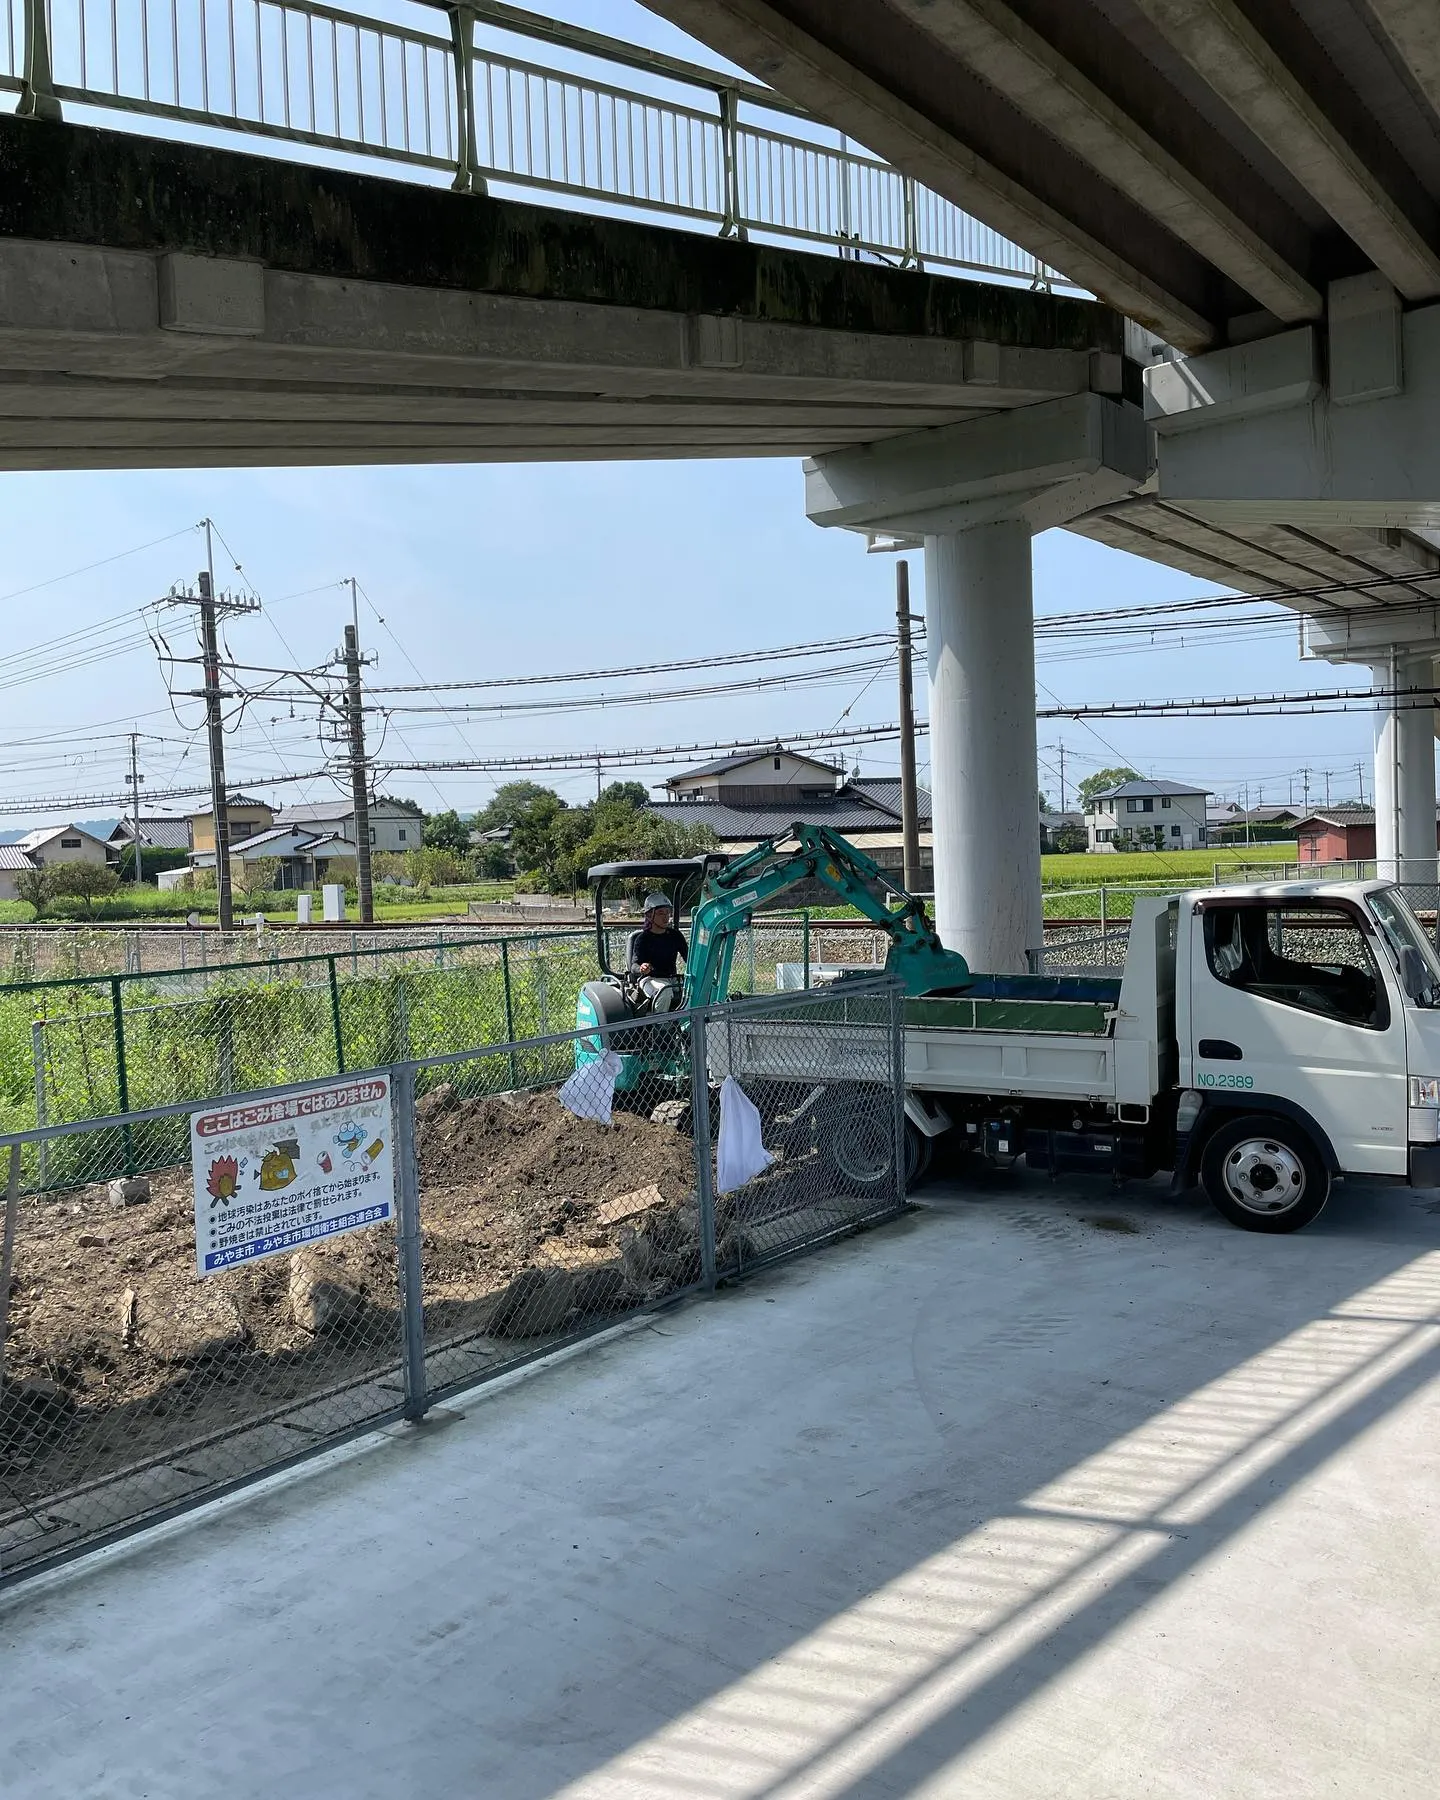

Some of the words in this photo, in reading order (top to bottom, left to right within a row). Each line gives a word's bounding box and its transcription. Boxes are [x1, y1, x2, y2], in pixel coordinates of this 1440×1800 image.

[1197, 1073, 1254, 1089] NO.2389
[203, 1084, 382, 1133] ここはごみ捨場ではありません
[218, 1171, 381, 1222] 地球汚染はあなたのポイ捨てから始まります。
[218, 1188, 363, 1236] ごみの不法投棄は法律で罰せられます。
[213, 1207, 383, 1266] みやま市・みやま市環境衛生組合連合会
[218, 1211, 323, 1249] 野焼きは禁止されています。
